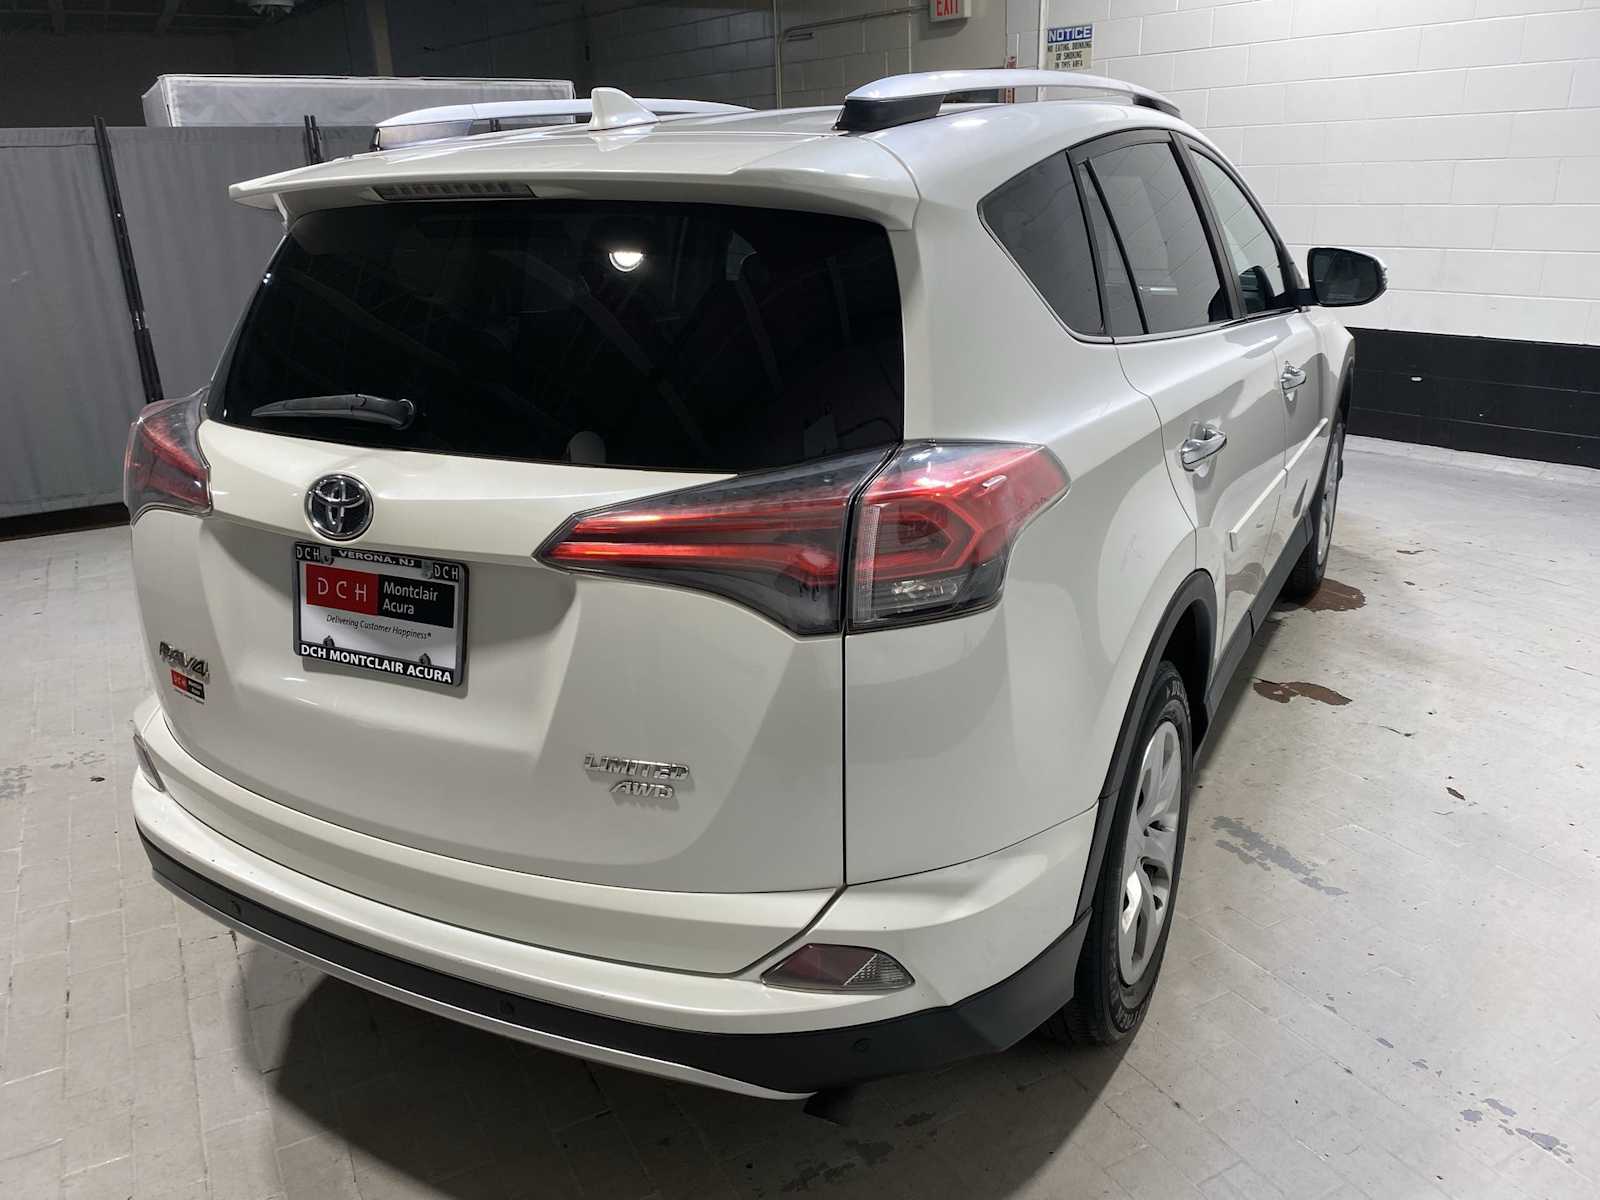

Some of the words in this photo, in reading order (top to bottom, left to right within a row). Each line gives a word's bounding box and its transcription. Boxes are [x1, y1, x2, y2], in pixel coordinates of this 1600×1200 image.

[1048, 26, 1092, 42] NOTICE
[1063, 51, 1082, 60] SMOKING
[296, 546, 320, 560] DCH
[399, 558, 415, 567] NJ
[434, 564, 459, 580] DCH
[317, 577, 367, 602] DCH
[383, 581, 438, 601] Montclair
[382, 598, 415, 615] Acura
[326, 614, 359, 629] Delivering
[360, 619, 392, 634] Customer
[159, 641, 208, 677] RAV4
[301, 644, 327, 660] DCH
[329, 650, 403, 673] MONTCLAIR
[406, 666, 452, 683] ACURA
[584, 756, 689, 779] LIMITED
[609, 781, 674, 799] AWD
